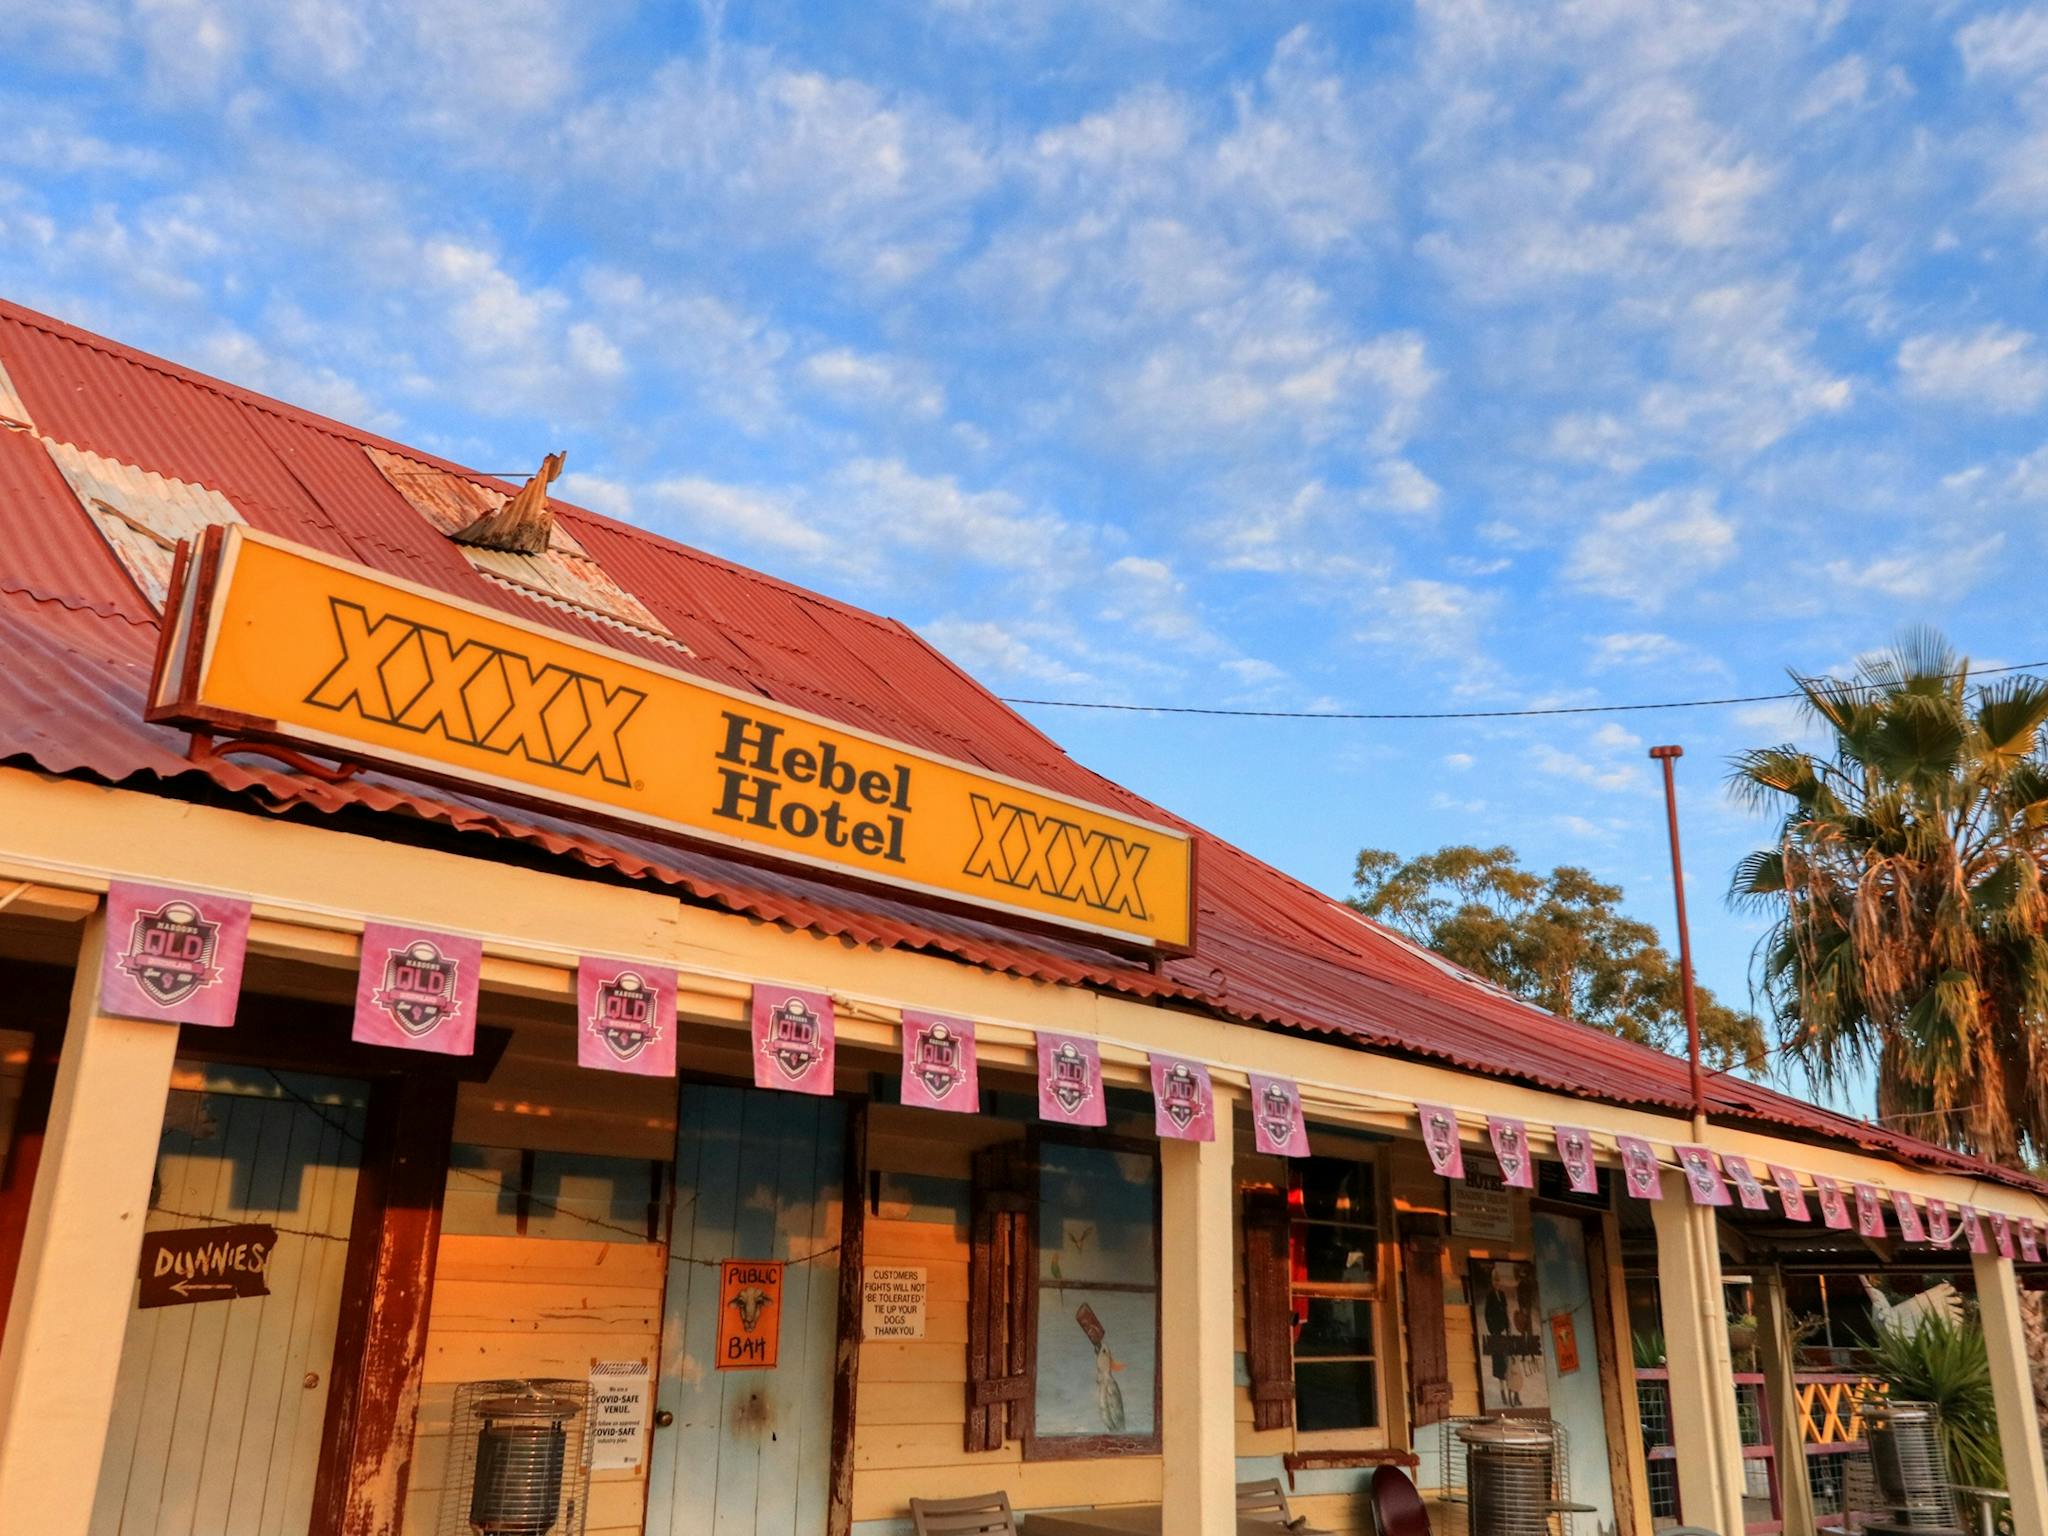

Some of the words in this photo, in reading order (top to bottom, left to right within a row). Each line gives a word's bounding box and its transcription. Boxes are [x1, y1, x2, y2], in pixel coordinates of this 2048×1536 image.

[303, 596, 648, 788] XXXX
[715, 710, 913, 813] Hebel
[712, 766, 906, 864] Hotel
[962, 792, 1150, 921] XXXX
[157, 922, 198, 934] MAROONS
[144, 929, 203, 961] QLD
[396, 966, 445, 994] QLD
[606, 996, 647, 1021] QLD
[779, 1020, 812, 1043] QLD
[923, 1044, 952, 1066] QLD
[1170, 1081, 1193, 1100] QLD
[154, 1241, 265, 1279] DUNNIES
[728, 1267, 777, 1285] PUBLIC
[873, 1270, 918, 1280] CUSTOMERS
[865, 1282, 892, 1292] FIGHTS
[893, 1283, 909, 1292] WILL
[911, 1283, 925, 1292] NOT
[867, 1293, 877, 1302] BE
[879, 1293, 921, 1303] TOLERATED
[874, 1304, 884, 1313] TIE
[886, 1305, 896, 1314] UP
[898, 1305, 917, 1314] YOUR
[884, 1315, 906, 1325] DOGS
[596, 1395, 640, 1404] COVID-SAFE
